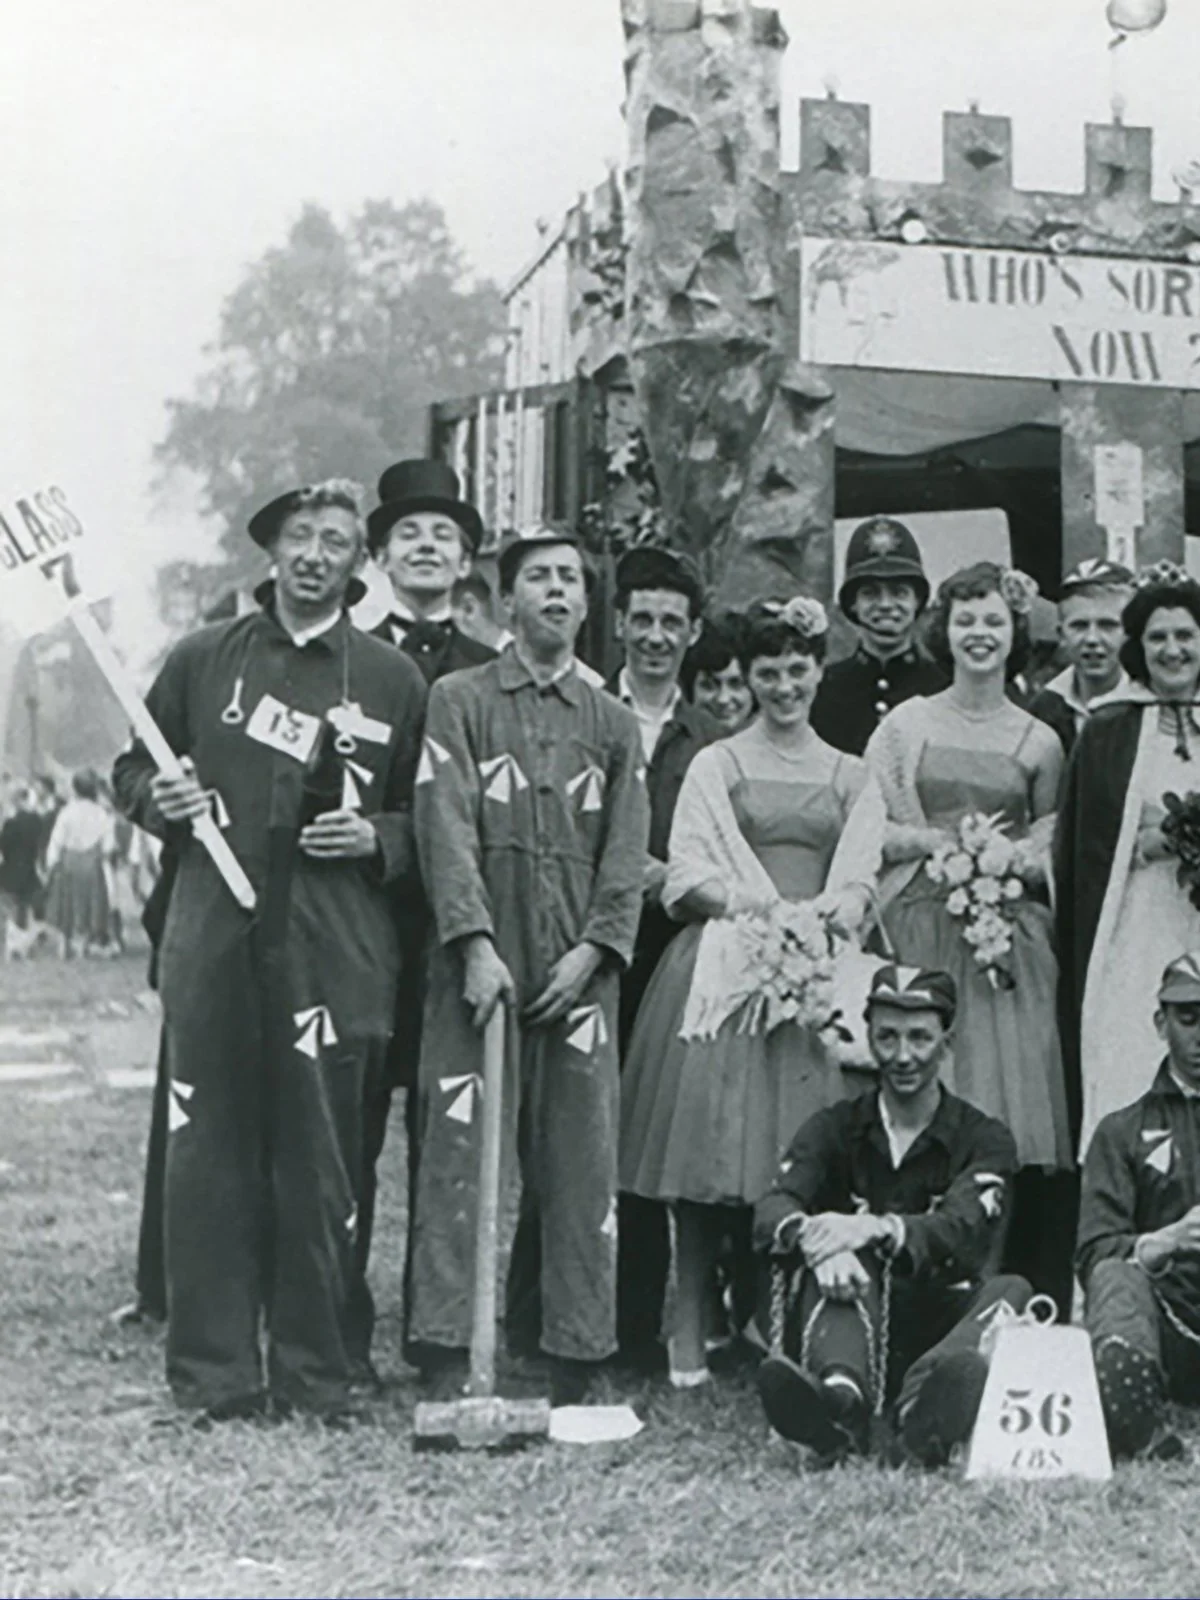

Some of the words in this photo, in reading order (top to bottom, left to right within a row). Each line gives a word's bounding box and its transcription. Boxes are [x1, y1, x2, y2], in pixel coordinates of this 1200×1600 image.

[940, 253, 1084, 305] WHO'S
[1052, 325, 1162, 381] NOW
[38, 552, 82, 599] 7
[999, 1388, 1072, 1437] 56
